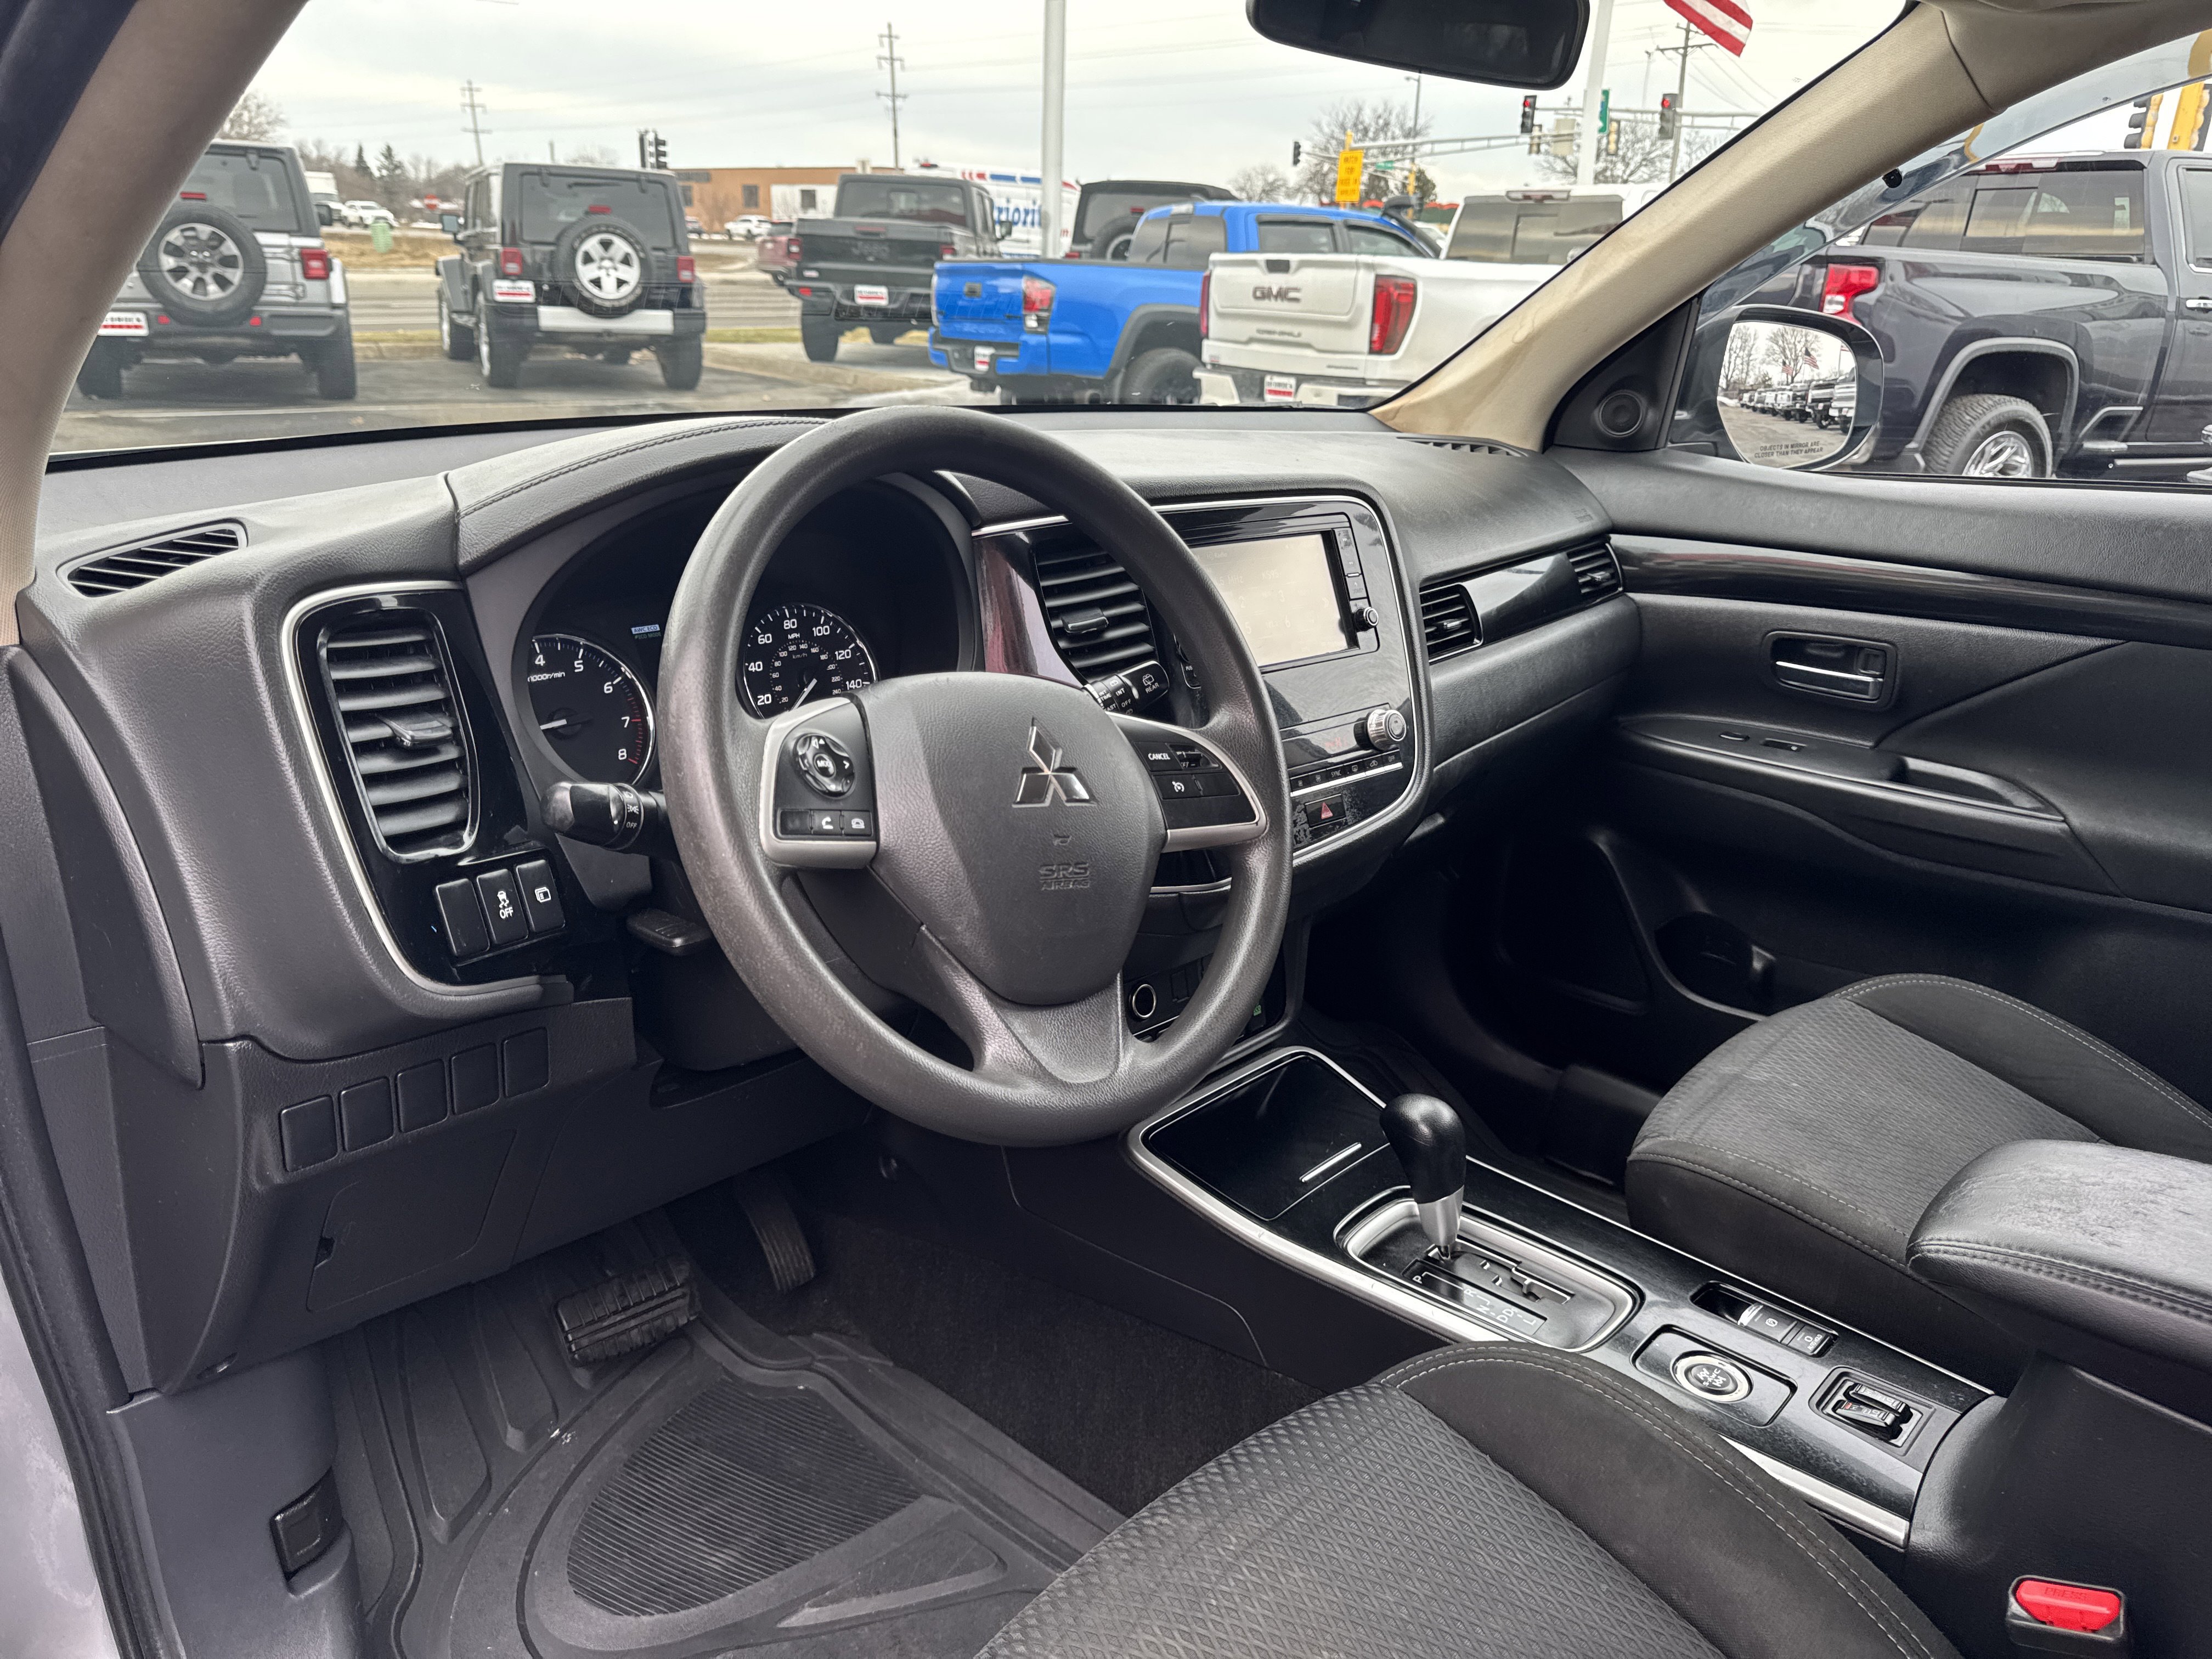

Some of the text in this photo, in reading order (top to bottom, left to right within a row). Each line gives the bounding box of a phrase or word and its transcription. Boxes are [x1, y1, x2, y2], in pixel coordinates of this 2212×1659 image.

[994, 197, 1042, 228] riori
[1252, 286, 1301, 301] GMC
[1278, 590, 1285, 602] 3
[783, 619, 797, 629] 80
[1285, 614, 1291, 628] 6
[812, 625, 830, 636] 100
[1244, 622, 1251, 634] 5
[758, 633, 772, 645] 60
[534, 654, 546, 666] 4
[835, 649, 851, 661] 120
[574, 660, 584, 673] 5
[748, 661, 763, 672] 40
[603, 682, 613, 694] 6
[845, 679, 862, 690] 140
[1145, 682, 1160, 694] REAR
[1101, 693, 1112, 702] TIME
[1115, 687, 1125, 697] INT
[757, 693, 772, 706] 20
[1121, 698, 1132, 708] OFF
[621, 716, 630, 728] 7
[618, 748, 627, 760] 8
[1330, 769, 1342, 778] SYNC
[1039, 861, 1090, 878] SRS
[1039, 879, 1090, 890] AIRBAG
[499, 906, 514, 919] OFF
[1412, 1275, 1423, 1284] P
[1464, 1289, 1476, 1297] R
[1476, 1305, 1489, 1314] N
[1496, 1314, 1509, 1324] D
[2044, 1586, 2087, 1600] PRESS
